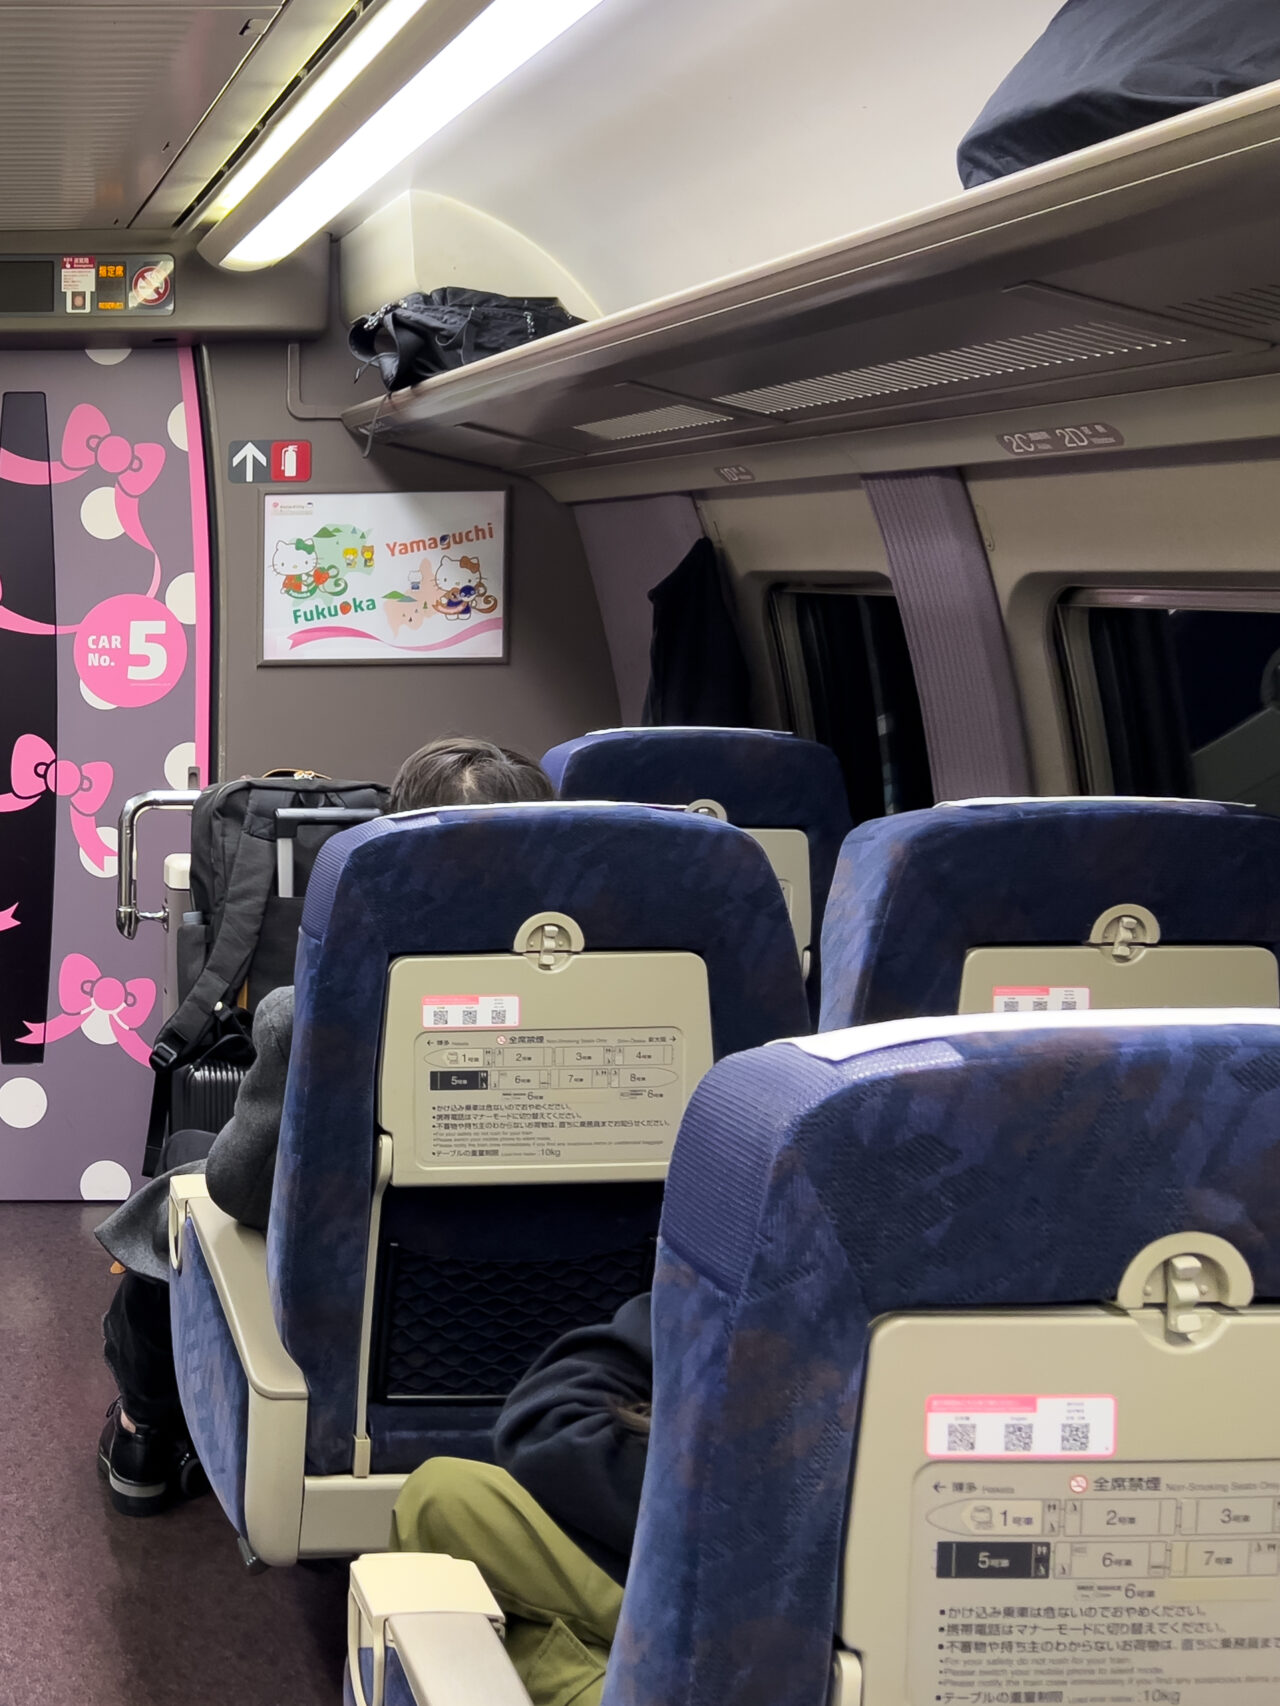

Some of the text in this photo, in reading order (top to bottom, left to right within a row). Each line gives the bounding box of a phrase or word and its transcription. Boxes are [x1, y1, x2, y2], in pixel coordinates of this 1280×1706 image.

[1002, 434, 1035, 454] 2C
[1053, 427, 1089, 447] 2D
[386, 523, 495, 557] Yamaguchi
[87, 635, 122, 649] CAR
[127, 620, 168, 681] 5
[87, 653, 115, 667] No.
[1093, 1477, 1161, 1491] 全席禁煙
